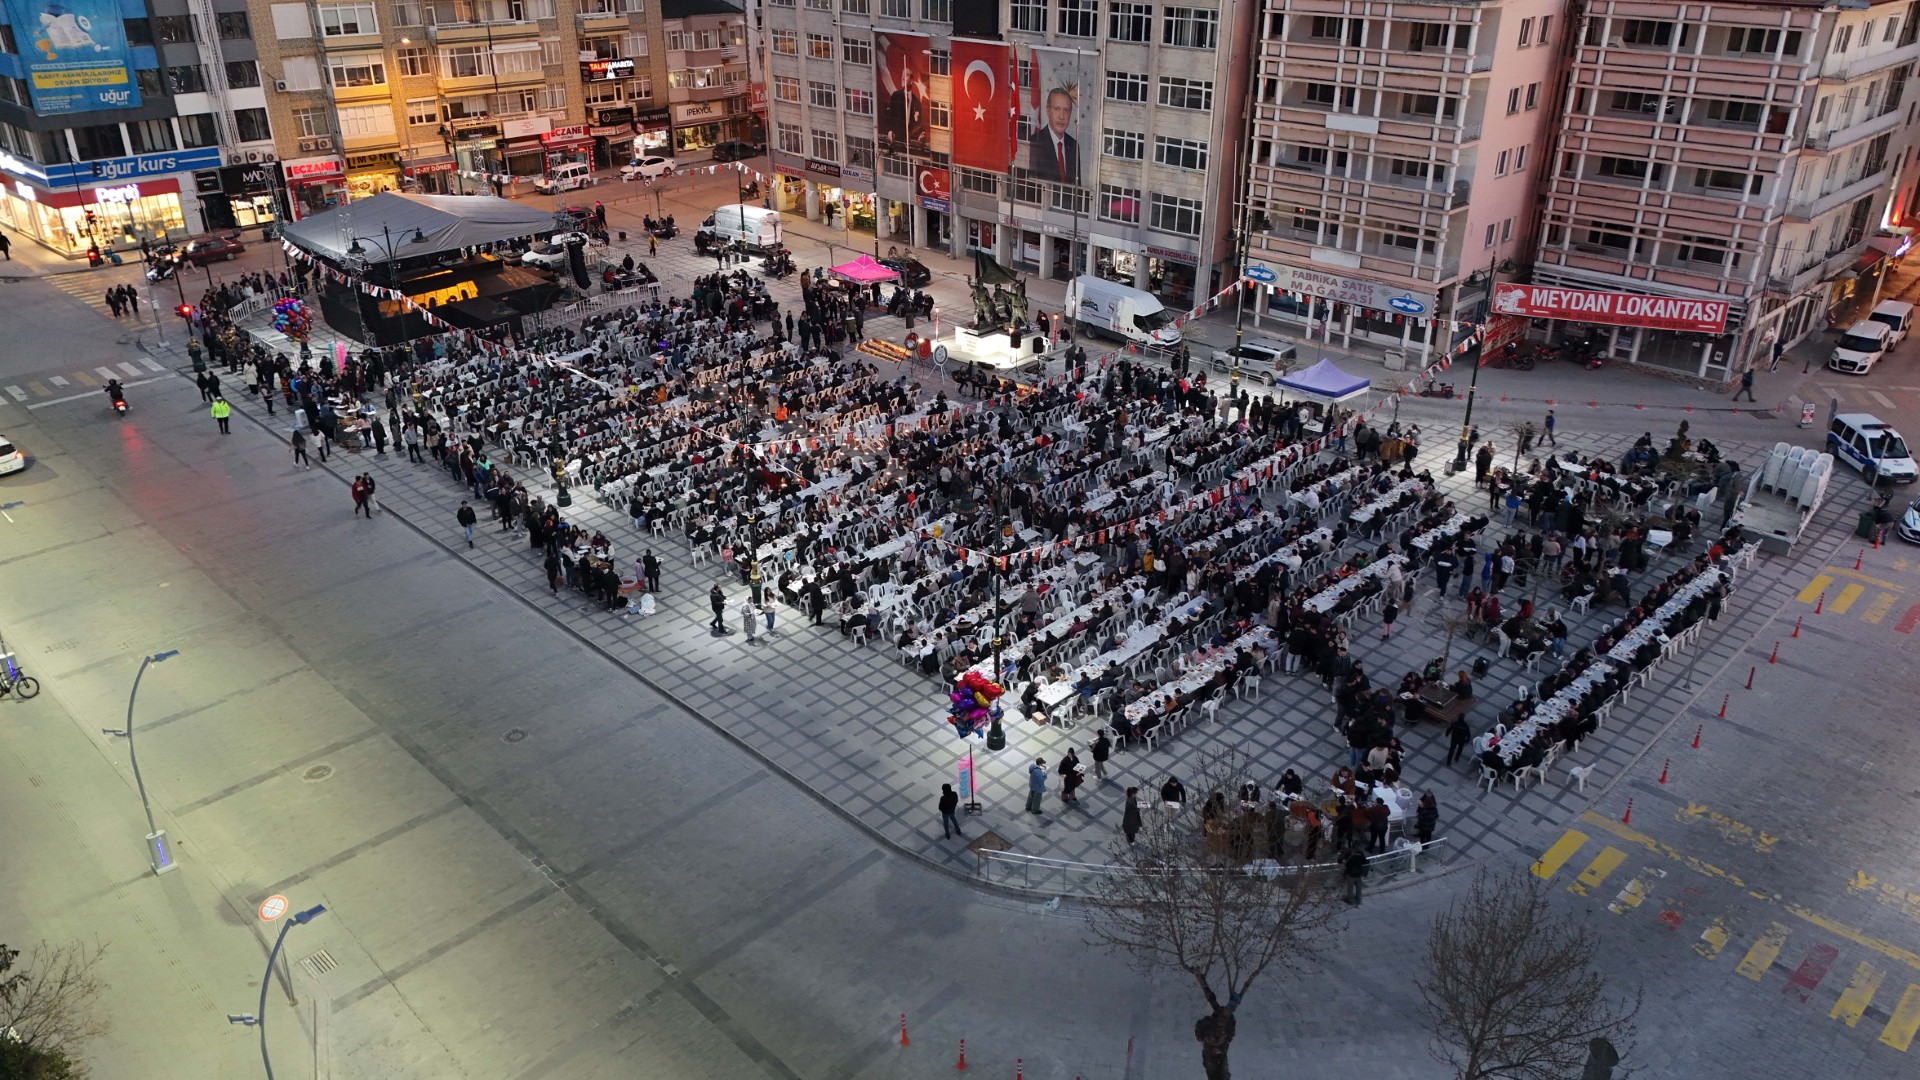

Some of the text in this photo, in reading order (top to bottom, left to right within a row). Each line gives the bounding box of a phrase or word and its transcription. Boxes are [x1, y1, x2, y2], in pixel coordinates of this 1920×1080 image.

[99, 89, 131, 104] uğur
[138, 156, 176, 173] kurs
[292, 161, 335, 175] ECZANE
[431, 163, 452, 172] DÖNER
[1291, 280, 1373, 305] MAĞAZASI
[1342, 280, 1374, 295] SATIŞ
[1530, 288, 1725, 323] MEYDAN LOKANTASI
